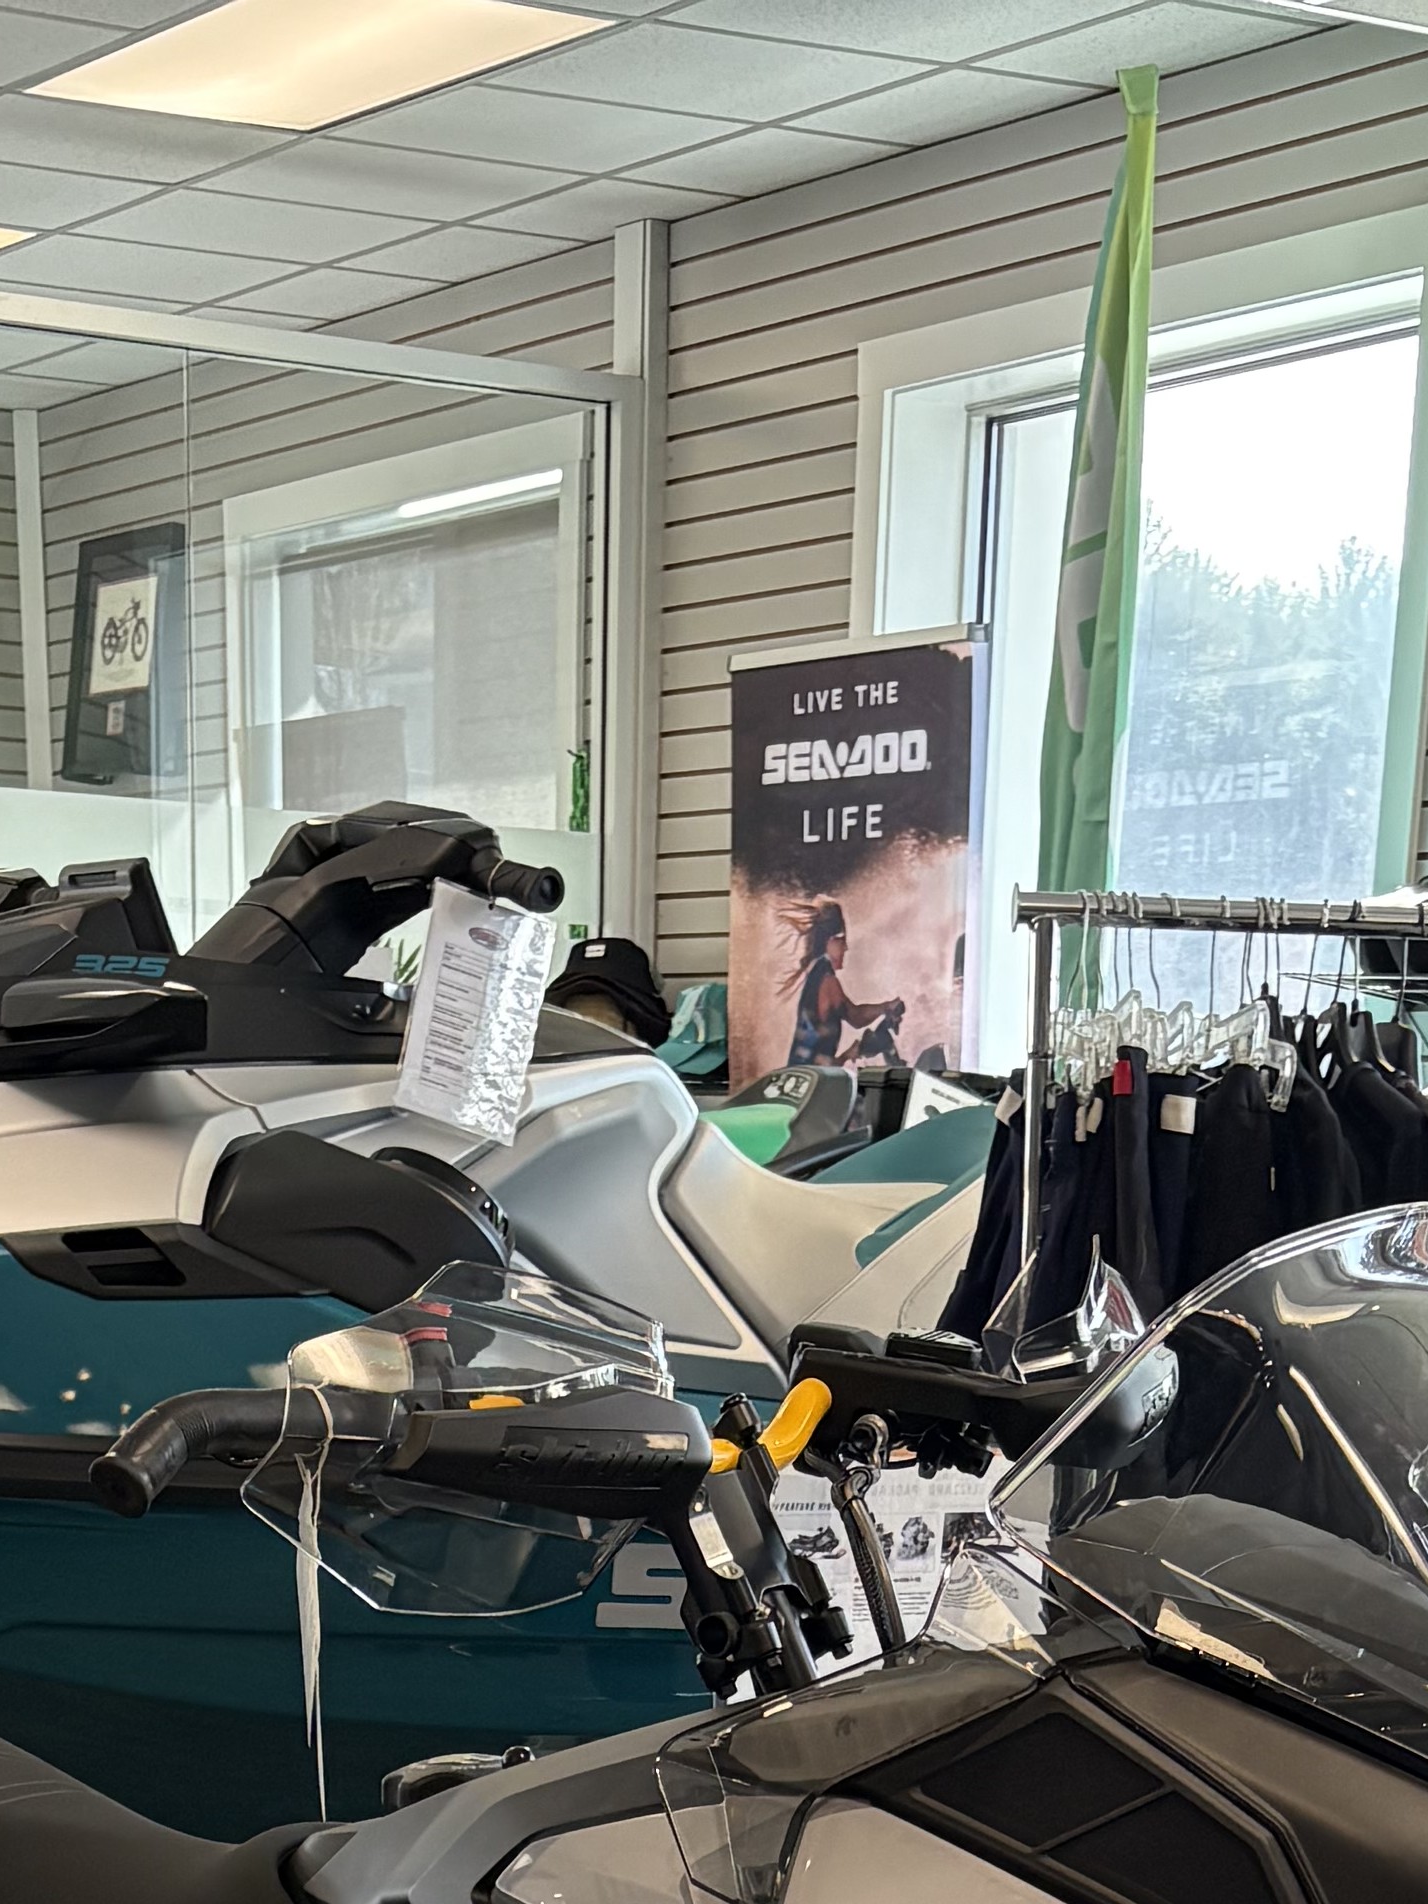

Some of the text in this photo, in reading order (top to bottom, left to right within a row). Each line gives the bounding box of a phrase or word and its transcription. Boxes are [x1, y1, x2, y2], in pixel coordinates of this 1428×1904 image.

[793, 681, 899, 715] LIVE THE
[803, 804, 883, 843] LIFE
[72, 954, 170, 977] 325
